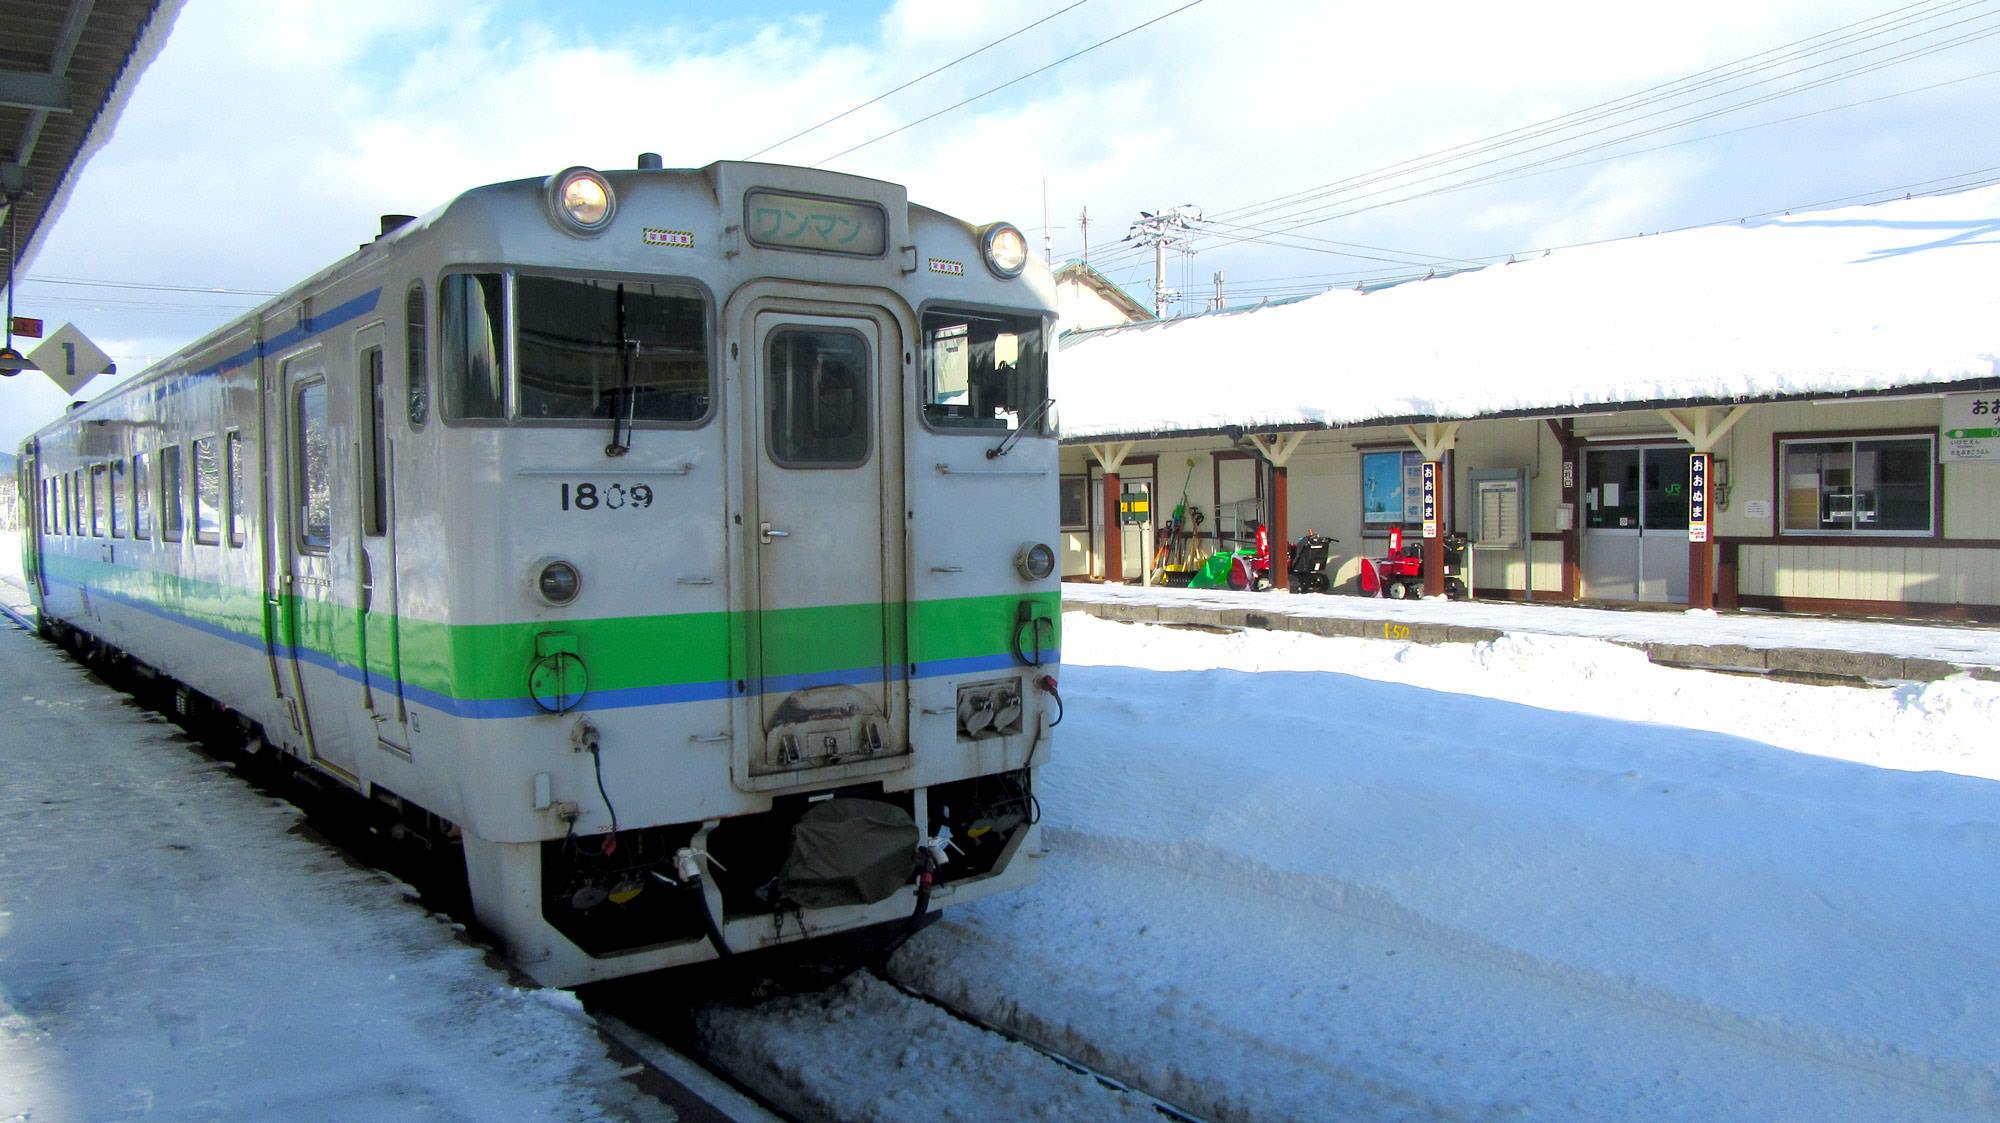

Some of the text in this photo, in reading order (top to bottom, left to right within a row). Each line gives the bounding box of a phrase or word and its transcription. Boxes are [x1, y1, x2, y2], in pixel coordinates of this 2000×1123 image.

[756, 208, 864, 244] ワンマン
[62, 342, 75, 376] 1
[1424, 467, 1434, 518] おおぬま
[1665, 483, 1681, 494] JR
[1693, 460, 1703, 518] おおぬま
